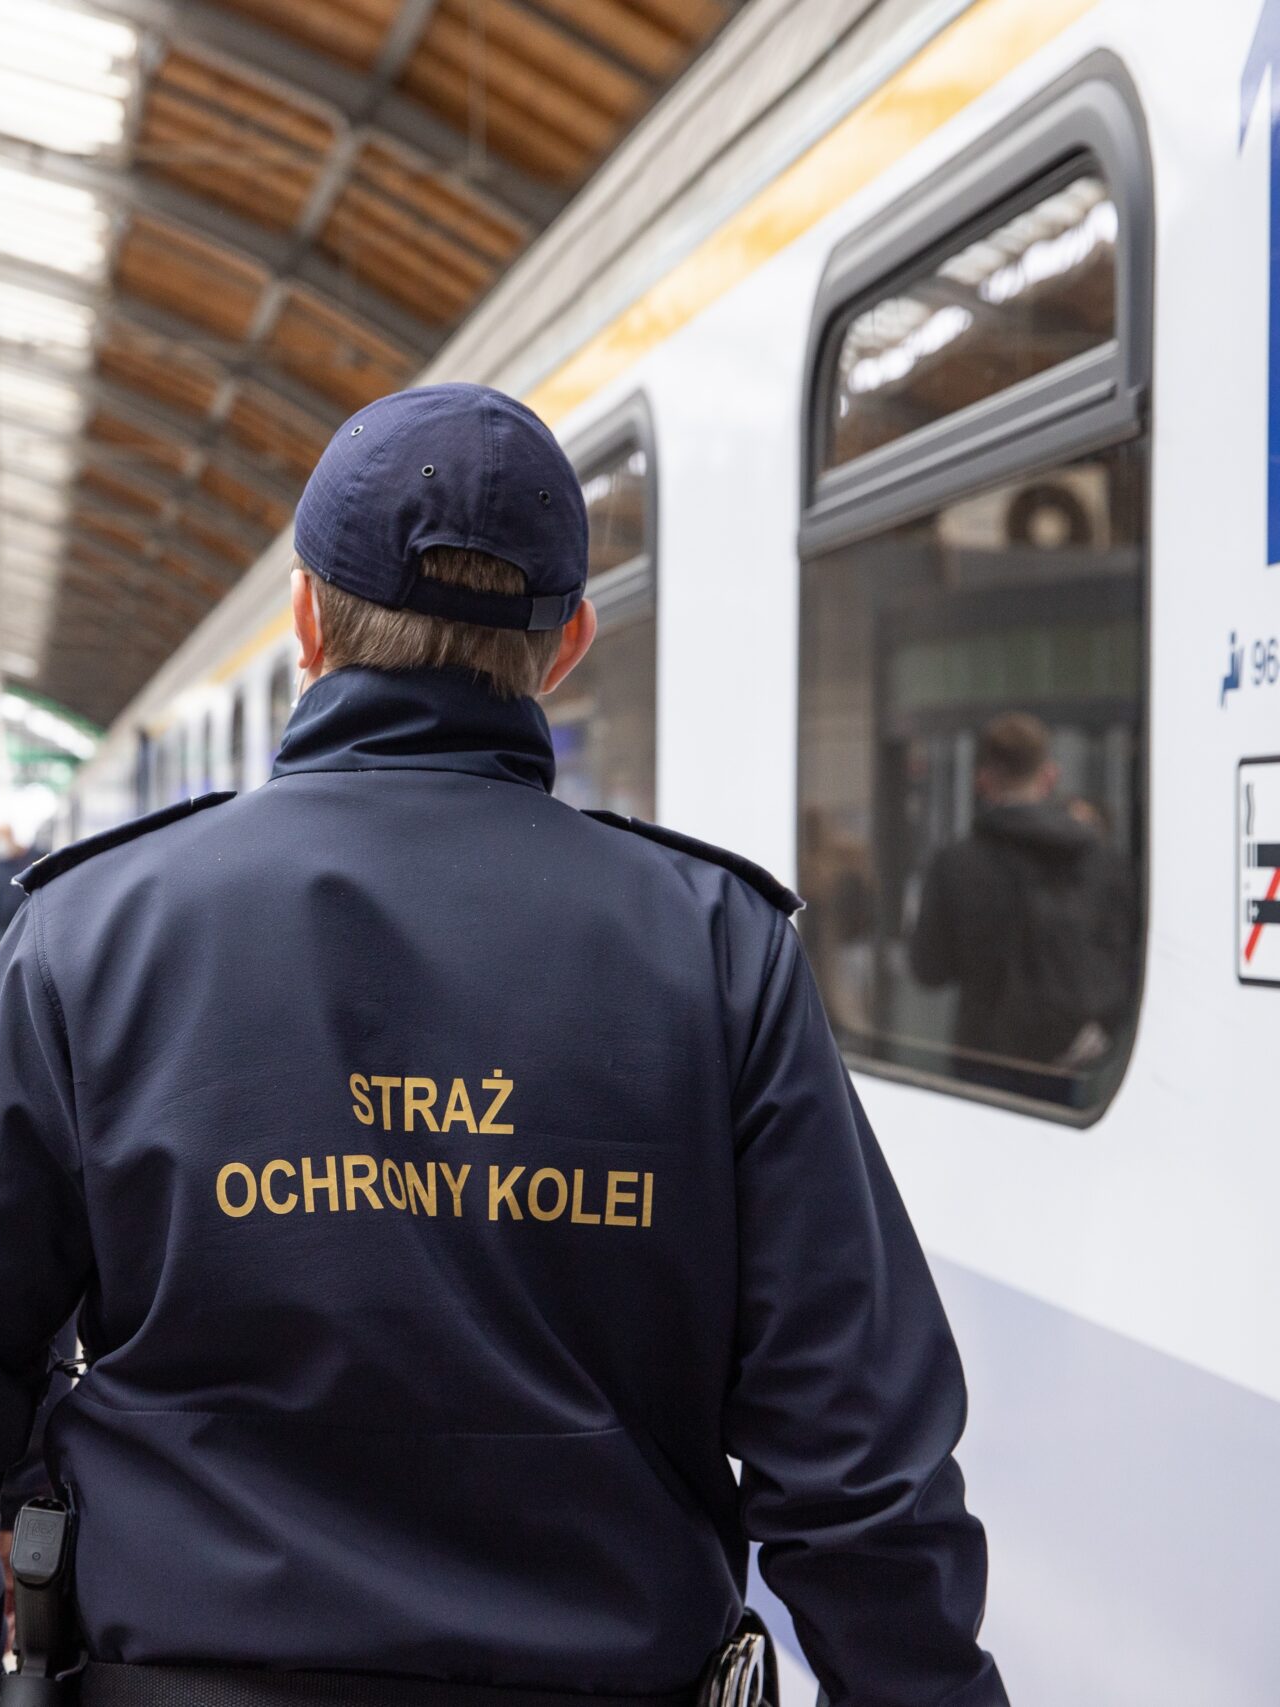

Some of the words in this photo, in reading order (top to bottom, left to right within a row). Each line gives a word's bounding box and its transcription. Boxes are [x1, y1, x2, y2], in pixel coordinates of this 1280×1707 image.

[349, 1068, 514, 1135] STRAŻ
[216, 1154, 472, 1218] OCHRONY
[487, 1165, 654, 1228] KOLEI
